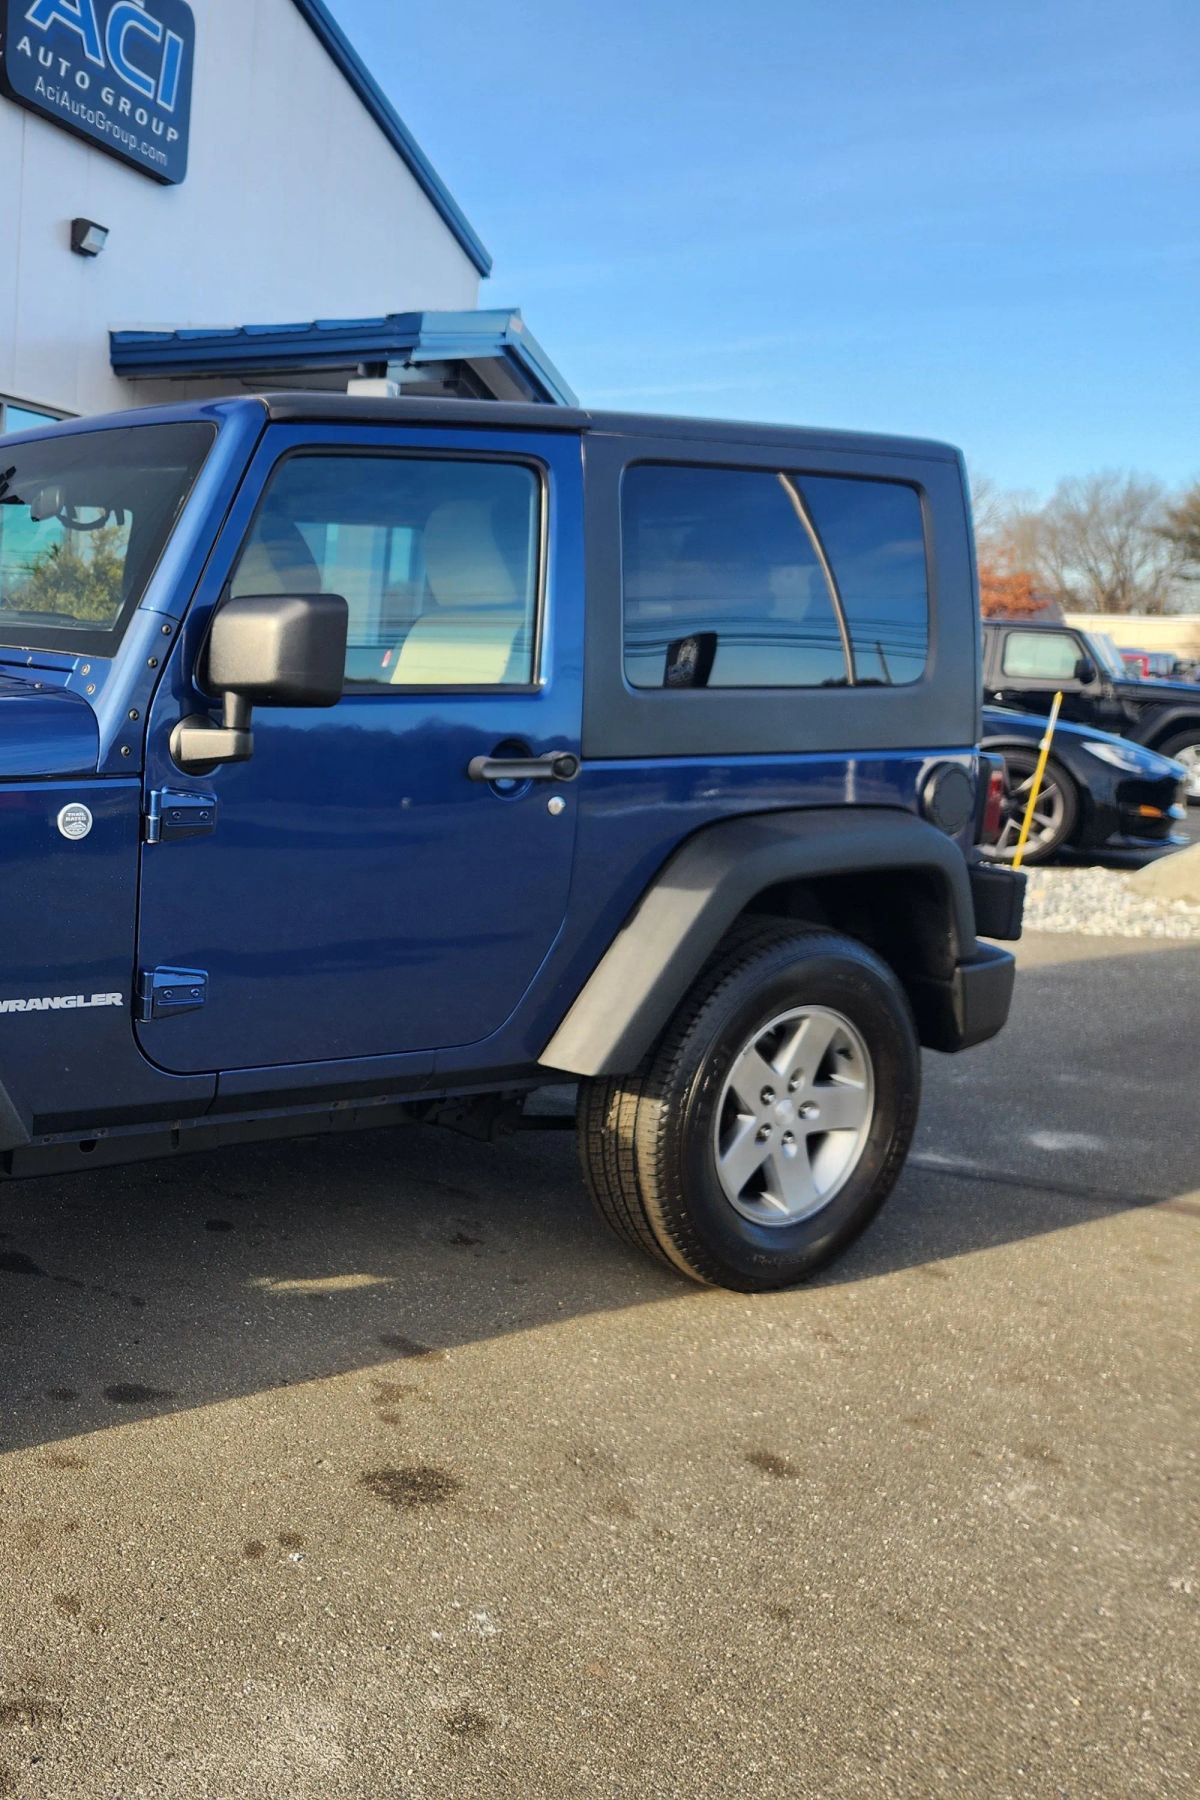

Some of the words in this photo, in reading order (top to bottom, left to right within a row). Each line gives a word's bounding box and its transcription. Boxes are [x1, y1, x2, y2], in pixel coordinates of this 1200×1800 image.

[16, 36, 90, 89] AUTO
[101, 86, 179, 142] GROUP
[25, 0, 184, 112] ACI
[34, 76, 168, 166] AciAutoGroup.com
